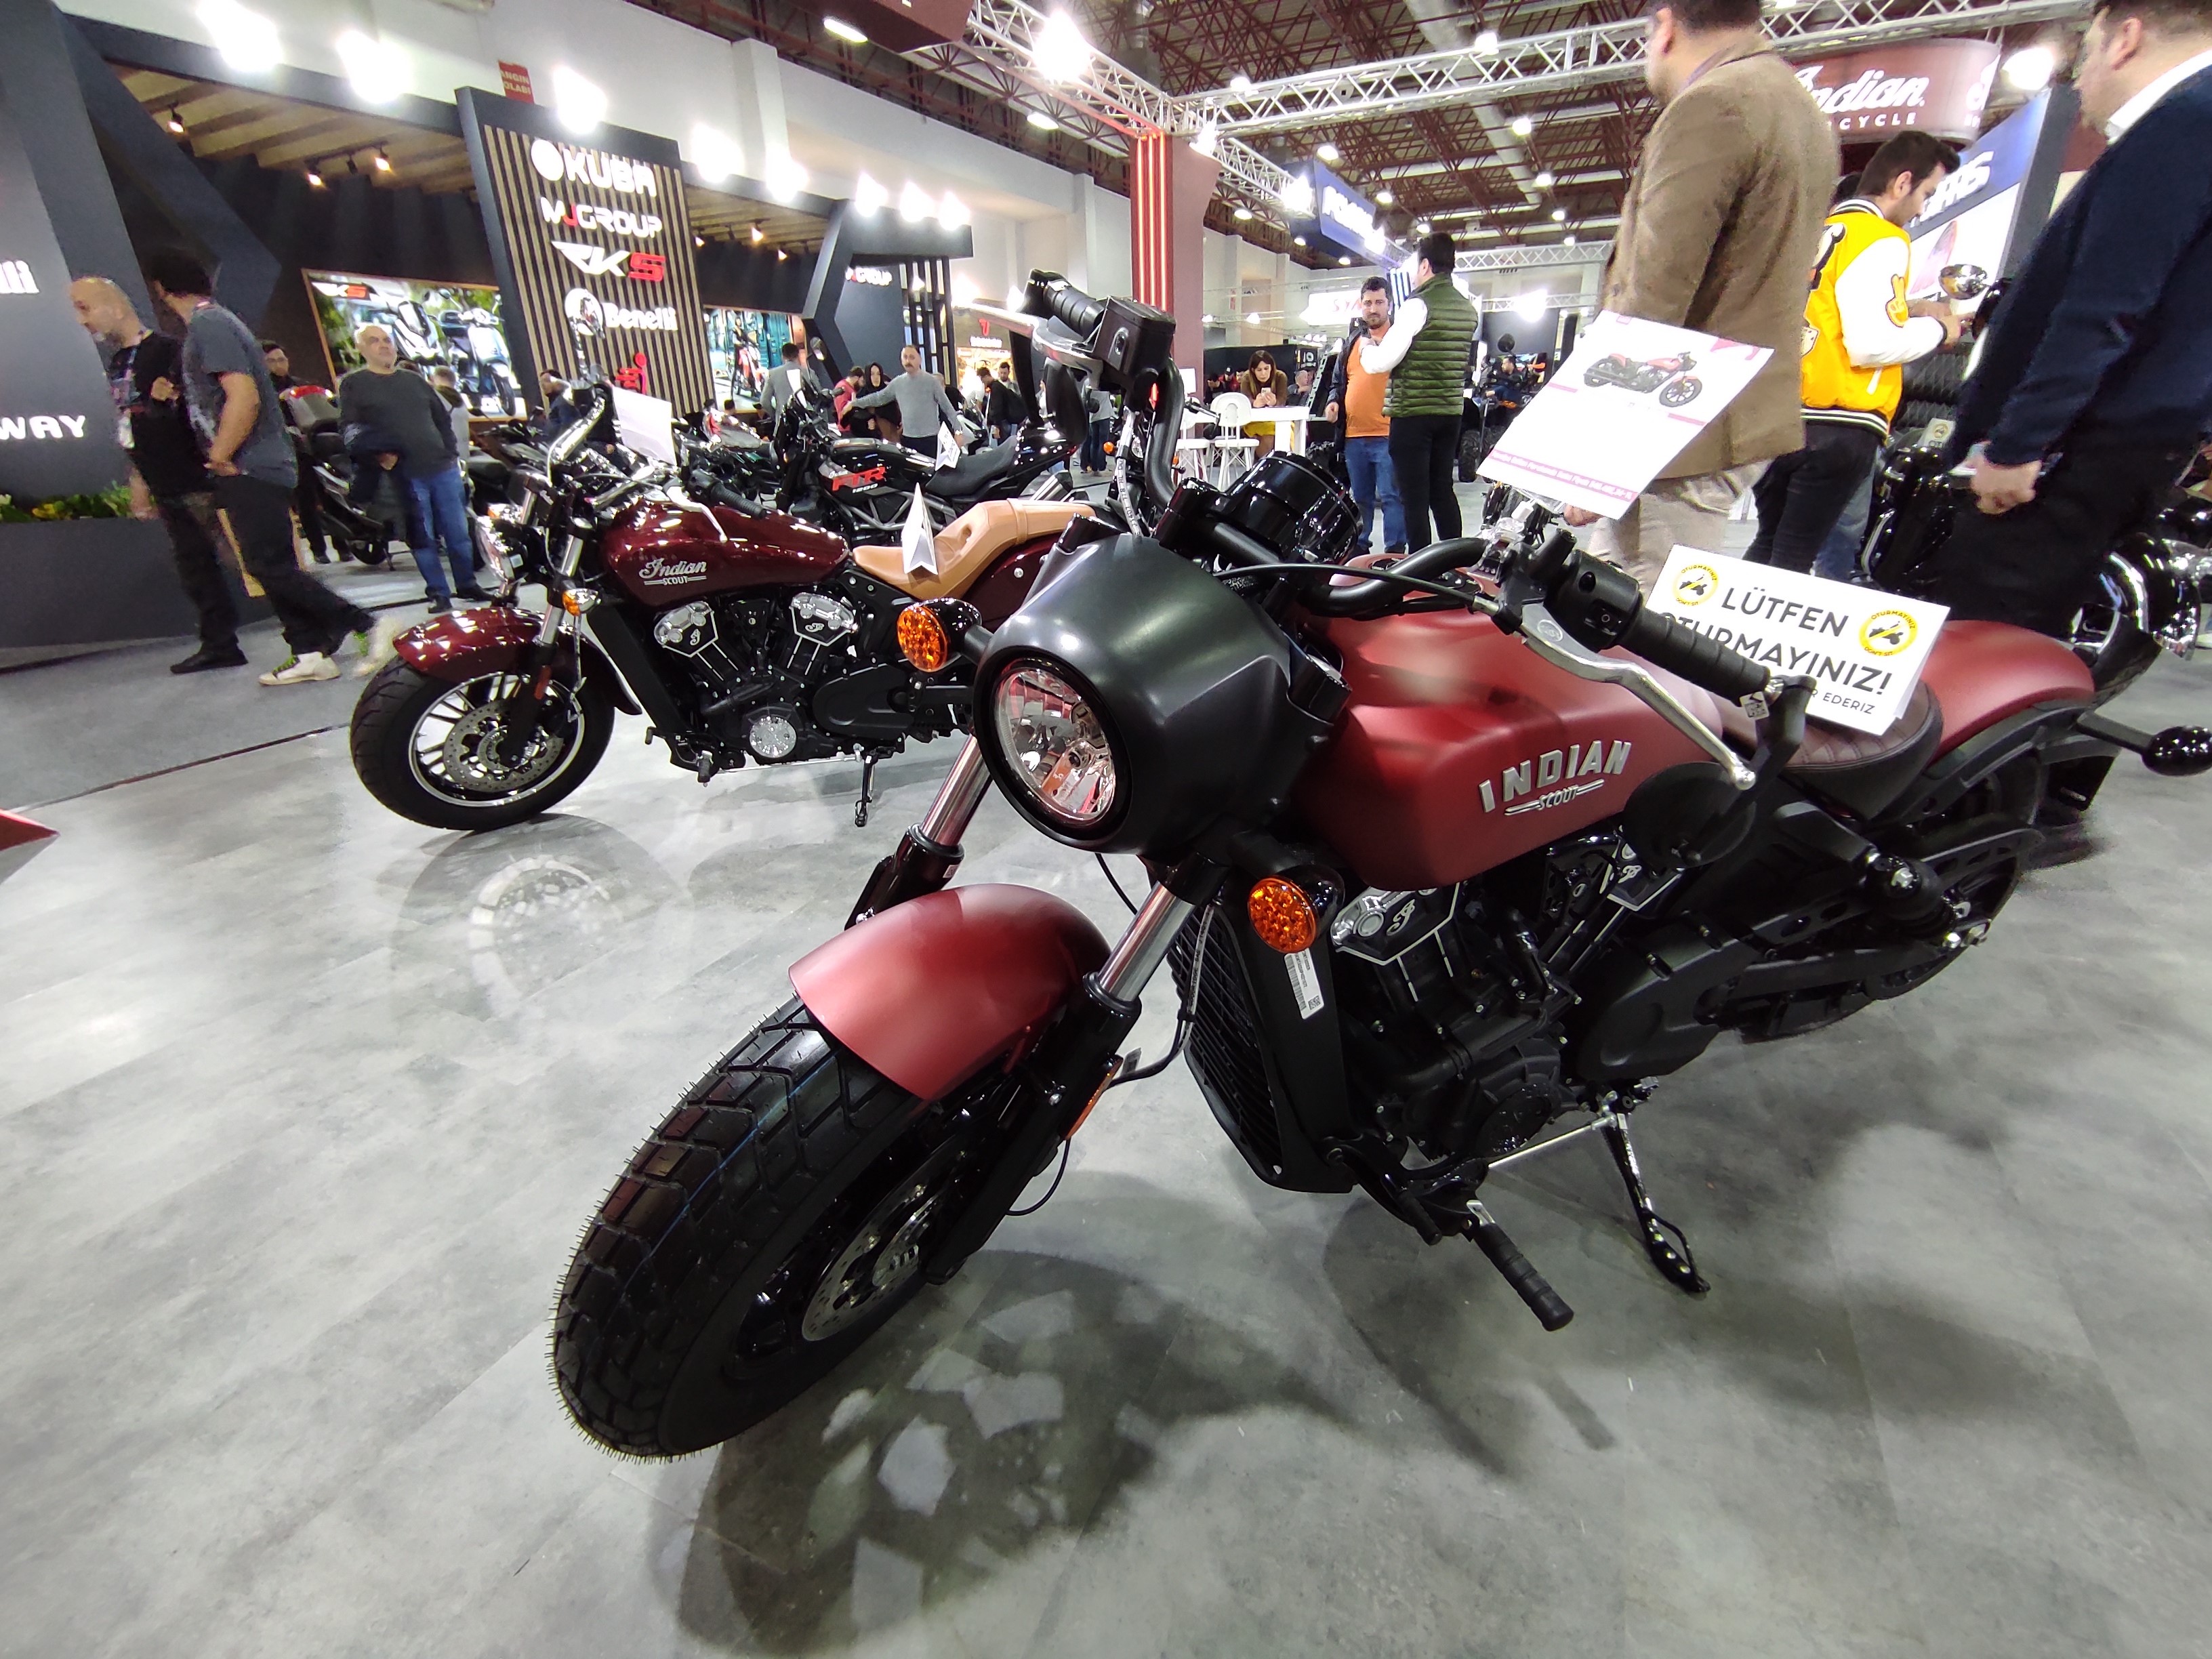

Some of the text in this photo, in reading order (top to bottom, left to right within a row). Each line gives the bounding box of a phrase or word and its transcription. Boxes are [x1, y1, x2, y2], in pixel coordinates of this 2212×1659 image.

[1827, 112, 1917, 131] CYCLE
[562, 148, 657, 197] KUBA
[832, 466, 886, 491] FTR
[853, 483, 878, 493] 1200
[639, 558, 707, 579] Indian
[663, 576, 689, 586] SCOUT
[1721, 587, 1849, 637] LÜTFEN
[1822, 692, 1876, 715] EDERIZ
[1478, 739, 1632, 813] INDIAN
[1536, 784, 1580, 811] SCOUT
